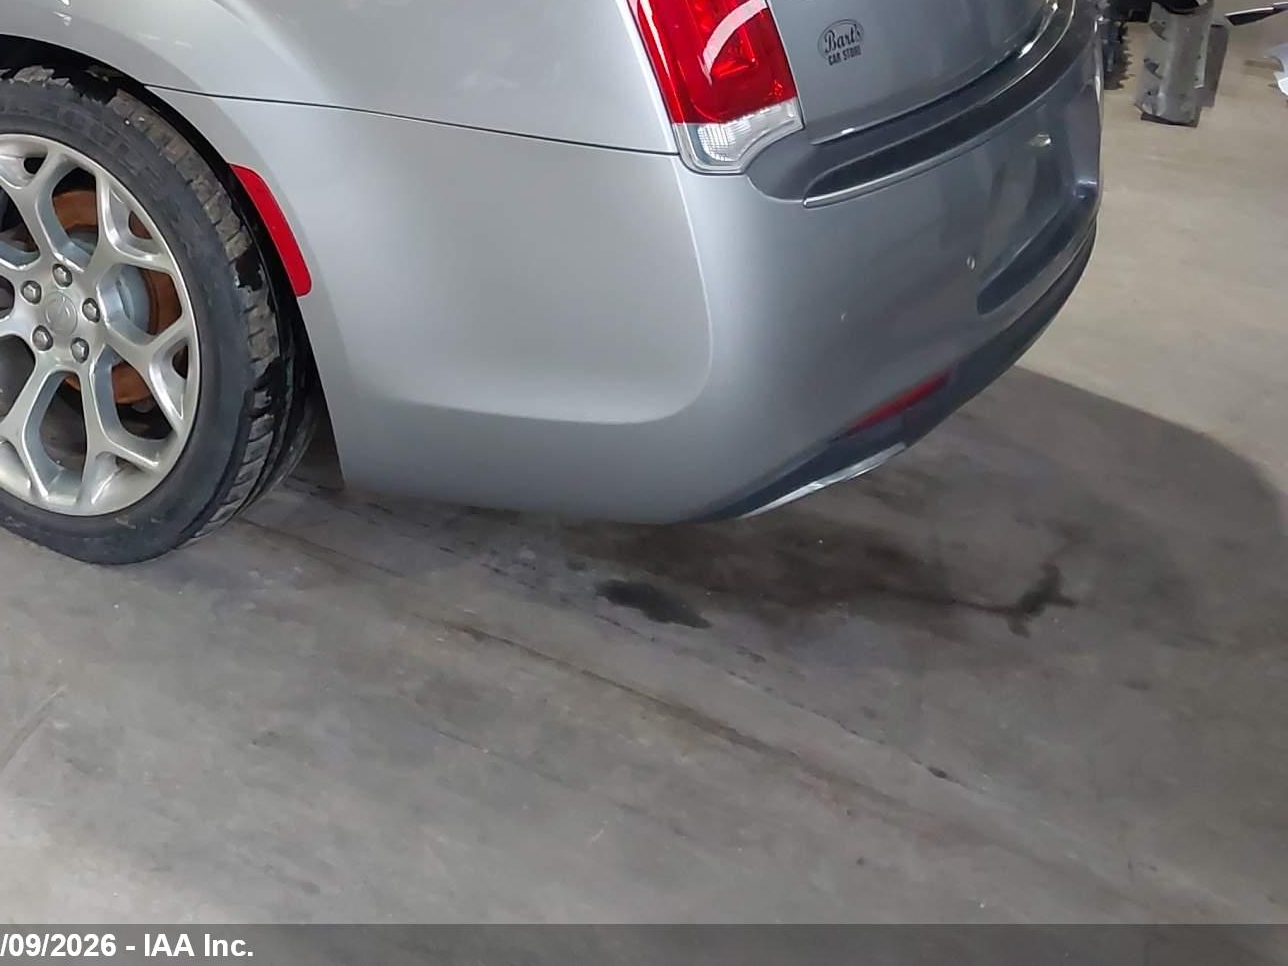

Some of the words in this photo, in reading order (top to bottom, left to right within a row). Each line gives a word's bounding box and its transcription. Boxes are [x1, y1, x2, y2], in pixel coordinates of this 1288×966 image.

[824, 24, 862, 53] Bart's
[828, 52, 842, 65] CAR
[842, 45, 862, 60] STORE
